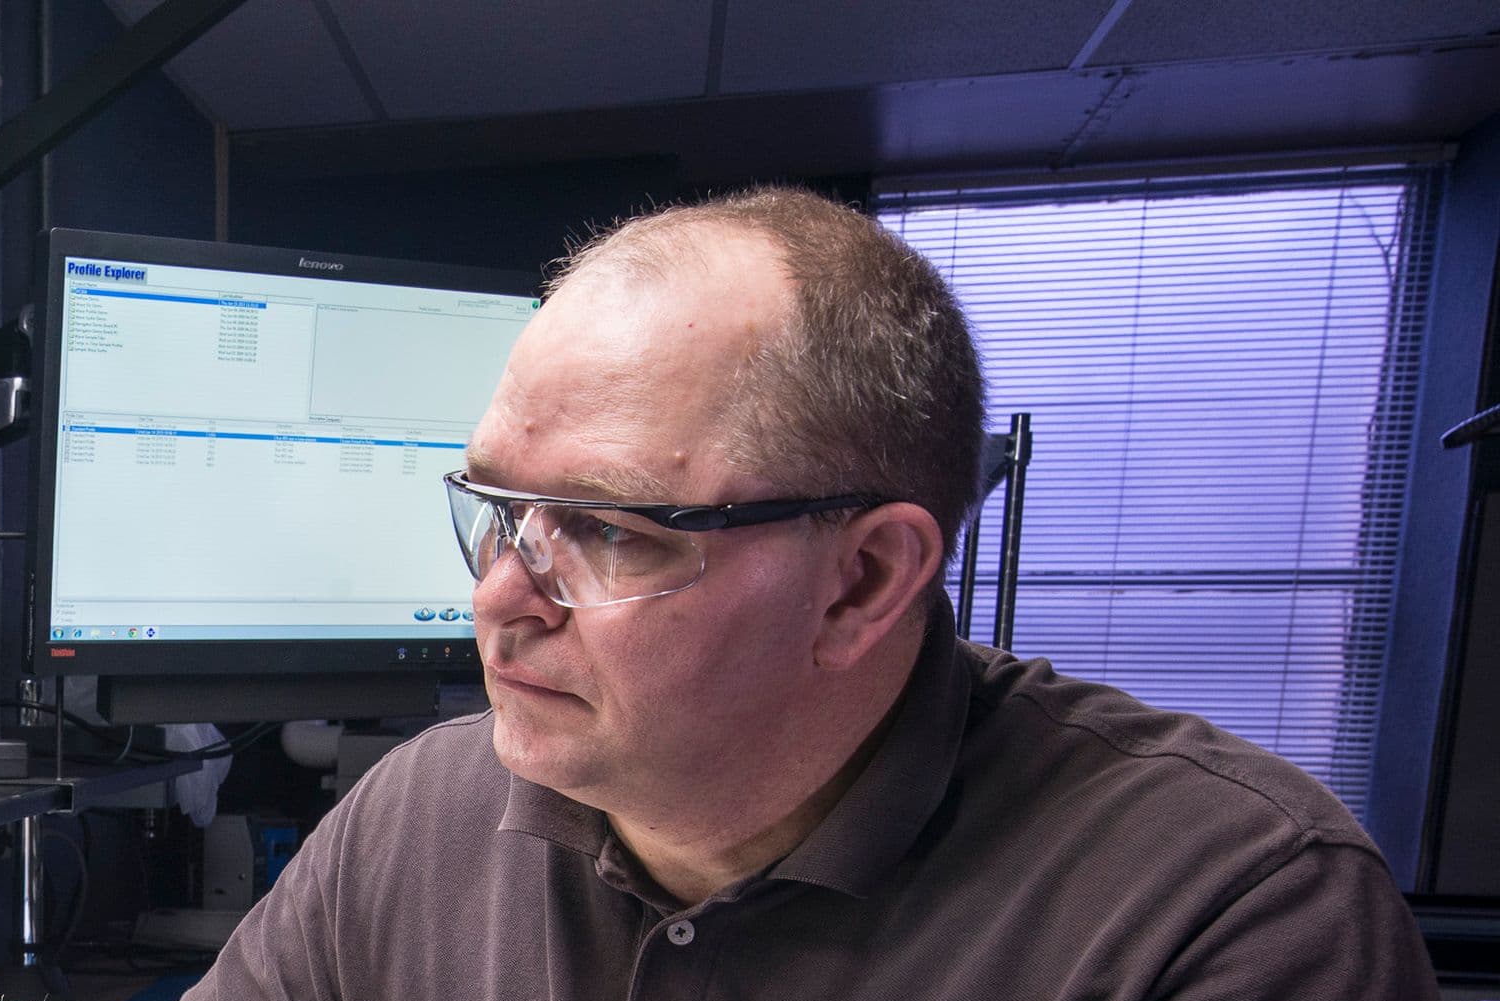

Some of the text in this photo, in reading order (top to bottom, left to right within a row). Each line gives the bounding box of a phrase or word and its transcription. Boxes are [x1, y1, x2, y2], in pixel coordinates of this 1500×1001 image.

[68, 262, 146, 281] Profile Explorer
[299, 257, 344, 270] lenovo
